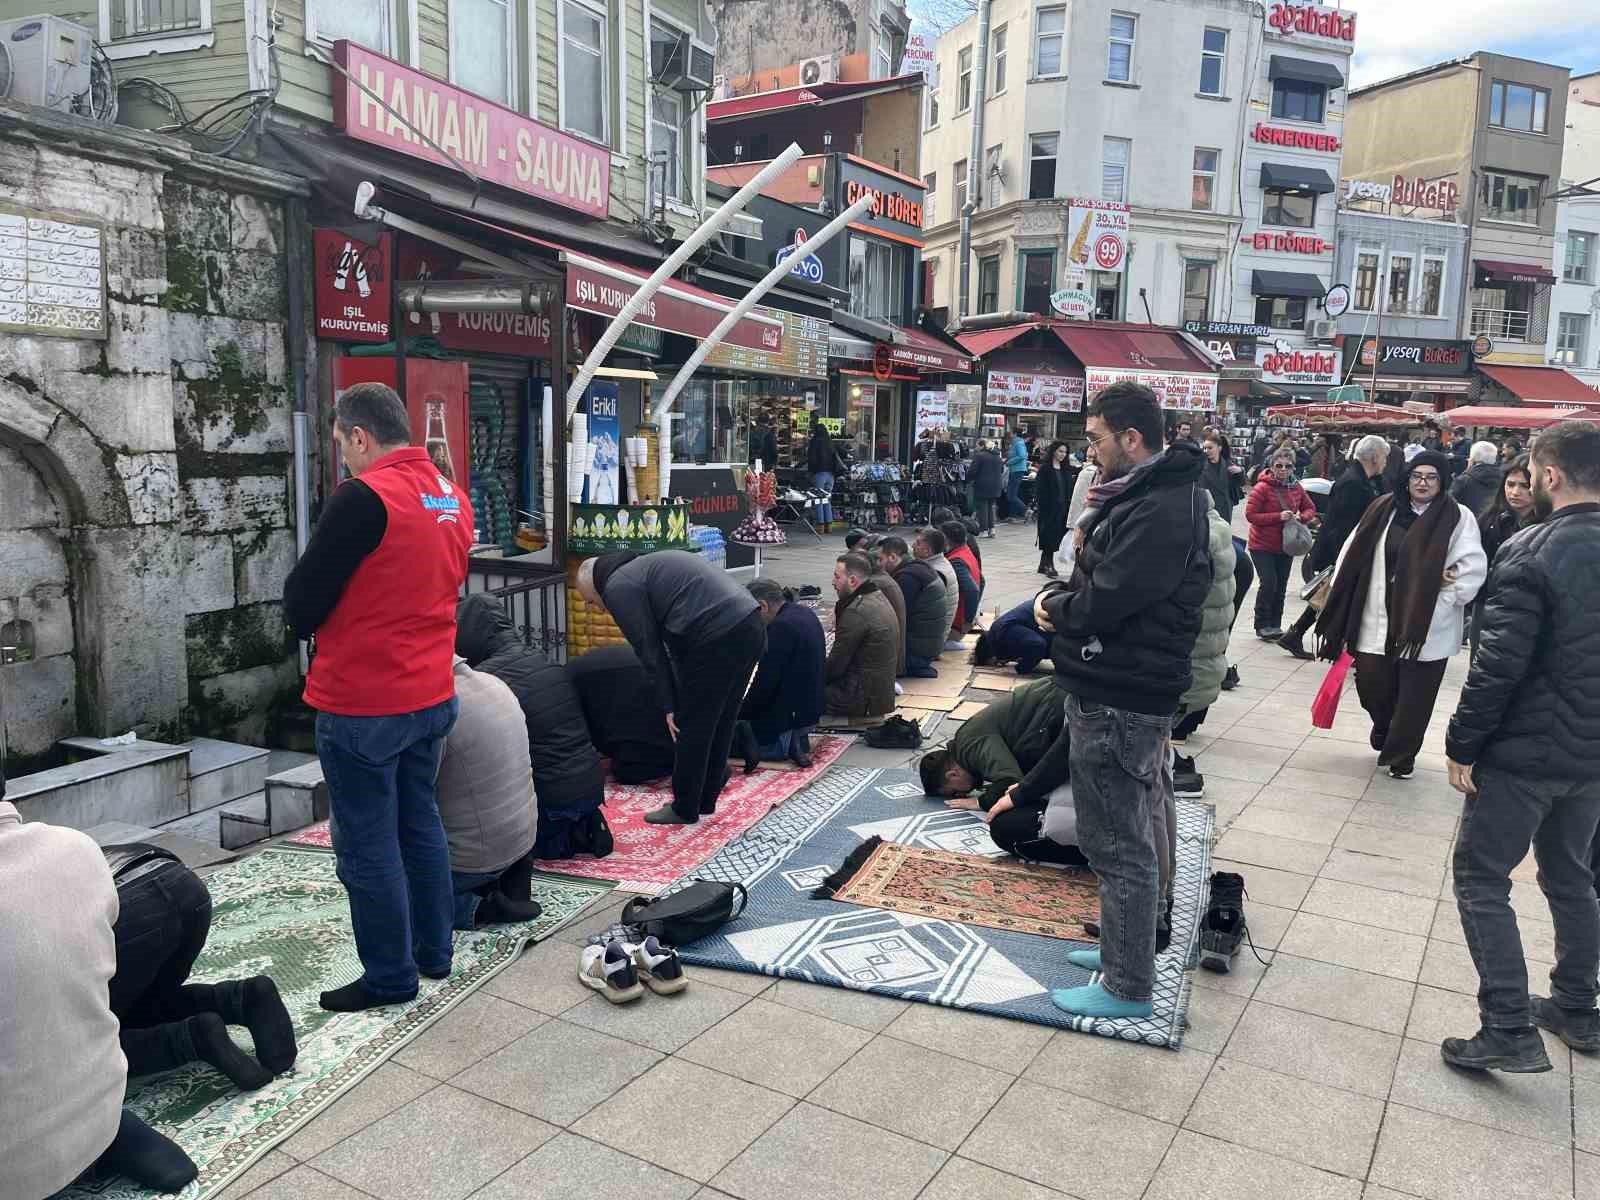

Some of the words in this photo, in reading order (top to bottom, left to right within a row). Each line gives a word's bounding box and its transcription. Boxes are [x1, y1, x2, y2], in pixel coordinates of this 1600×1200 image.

[360, 63, 489, 168] HAMAM
[515, 127, 604, 208] SAUNA
[1255, 122, 1338, 152] İSKENDER
[1343, 179, 1391, 202] yesen
[1100, 239, 1118, 261] 99
[1254, 233, 1273, 249] ET
[1275, 231, 1324, 254] DÖNER
[575, 279, 598, 304] IŞIL
[343, 305, 365, 319] IŞIL
[320, 318, 389, 336] KURUYEMİŞ
[458, 312, 551, 344] KURUYEMİŞ
[1208, 322, 1242, 335] EKRAN
[1382, 345, 1421, 364] yesen
[1423, 346, 1464, 365] BURGER
[1014, 384, 1032, 392] TAVA
[1061, 379, 1082, 387] TAVUK
[1166, 384, 1190, 394] DÖNER
[1167, 376, 1190, 385] TAVUK
[592, 397, 617, 416] Erikli
